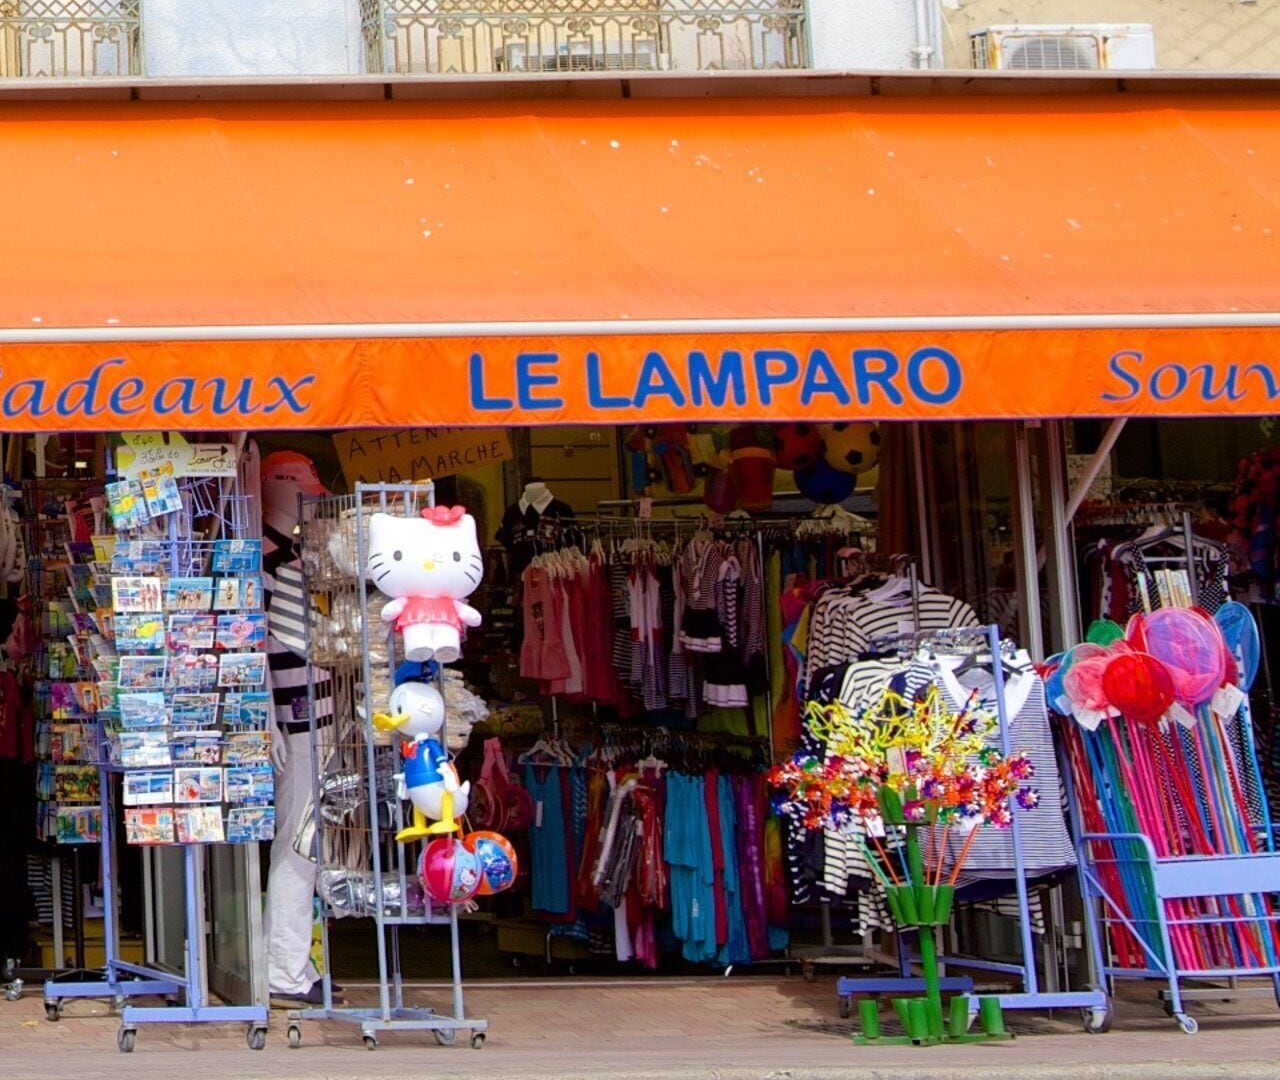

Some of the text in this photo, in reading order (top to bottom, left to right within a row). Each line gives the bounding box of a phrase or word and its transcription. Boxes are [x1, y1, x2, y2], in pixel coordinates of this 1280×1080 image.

[470, 346, 963, 410] LE LAMPARO
[410, 440, 505, 479] MARCHE
